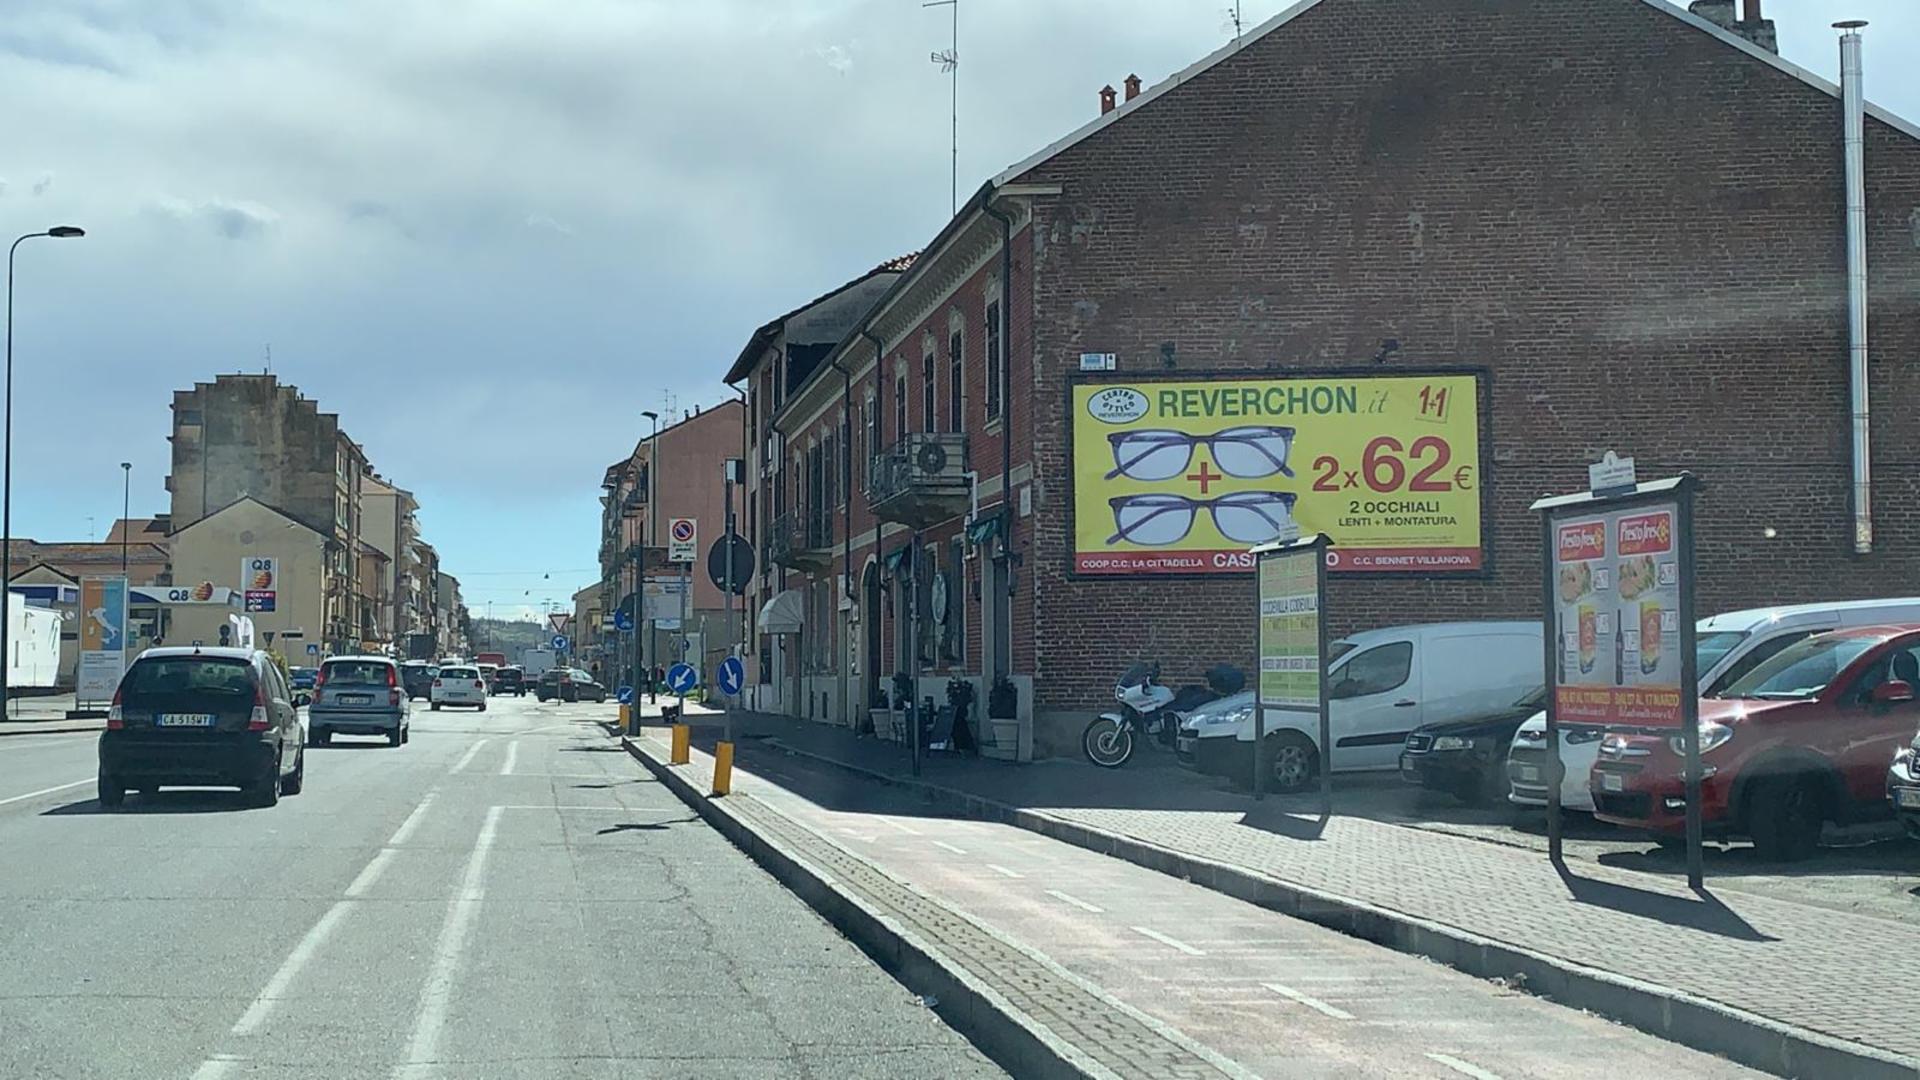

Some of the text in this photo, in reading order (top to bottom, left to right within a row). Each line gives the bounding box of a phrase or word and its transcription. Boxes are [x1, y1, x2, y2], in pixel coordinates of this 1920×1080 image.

[1102, 390, 1134, 402] CENTRO
[1102, 401, 1135, 412] OTTICO
[1349, 500, 1439, 513] 2 OCCHIALI
[1338, 517, 1371, 527] LENTI
[1384, 516, 1457, 526] MONTATURA
[252, 560, 271, 570] Q8
[1081, 560, 1109, 569] COOP
[1111, 560, 1131, 568] C.C.
[1132, 560, 1145, 568] LA
[1146, 559, 1204, 568] CITTADELLA
[1353, 557, 1373, 565] C.C.
[1375, 557, 1416, 565] BENNET
[1417, 556, 1471, 564] VILLANOVA
[168, 590, 189, 601] Q8
